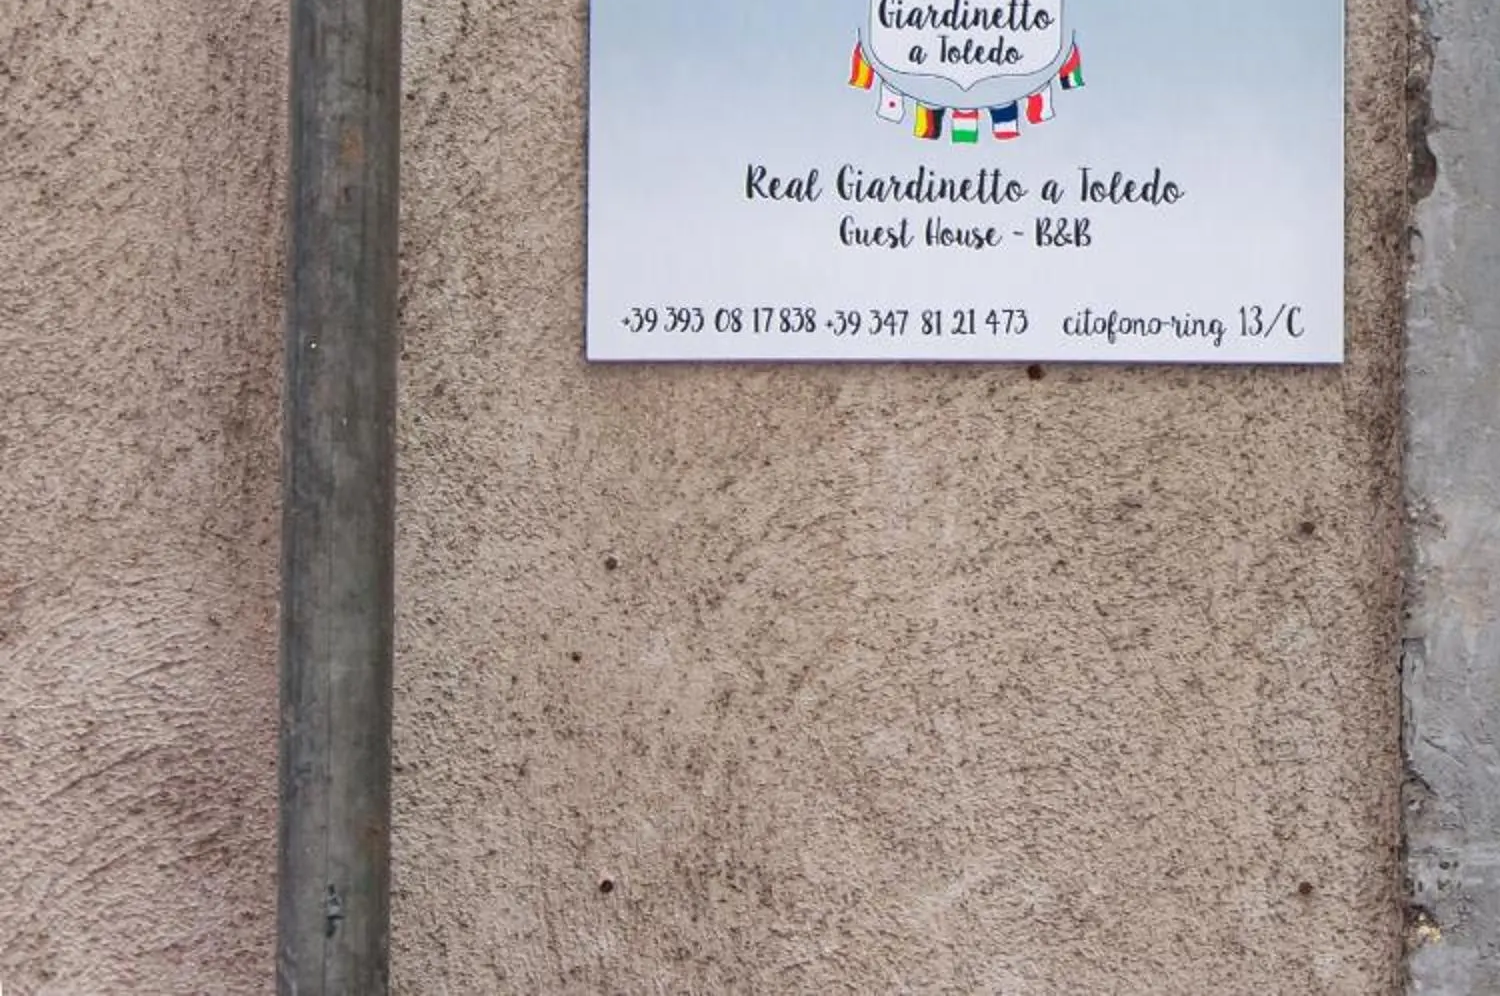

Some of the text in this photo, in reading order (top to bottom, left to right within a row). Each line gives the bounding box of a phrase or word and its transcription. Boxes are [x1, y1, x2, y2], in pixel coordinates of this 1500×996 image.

[908, 35, 1024, 65] a Toledo
[745, 163, 1186, 206] Real Giardinetto a Toledo
[839, 215, 915, 250] Guest
[925, 215, 1003, 250] House
[1035, 216, 1093, 248] B&B
[621, 306, 658, 333] +39
[663, 306, 705, 333] 393
[714, 307, 743, 333] 08
[825, 309, 862, 336] +39
[868, 309, 909, 336] 347
[921, 309, 942, 336] 81
[950, 308, 976, 335] 21
[984, 309, 1029, 335] 473
[1239, 303, 1305, 338] 13/C
